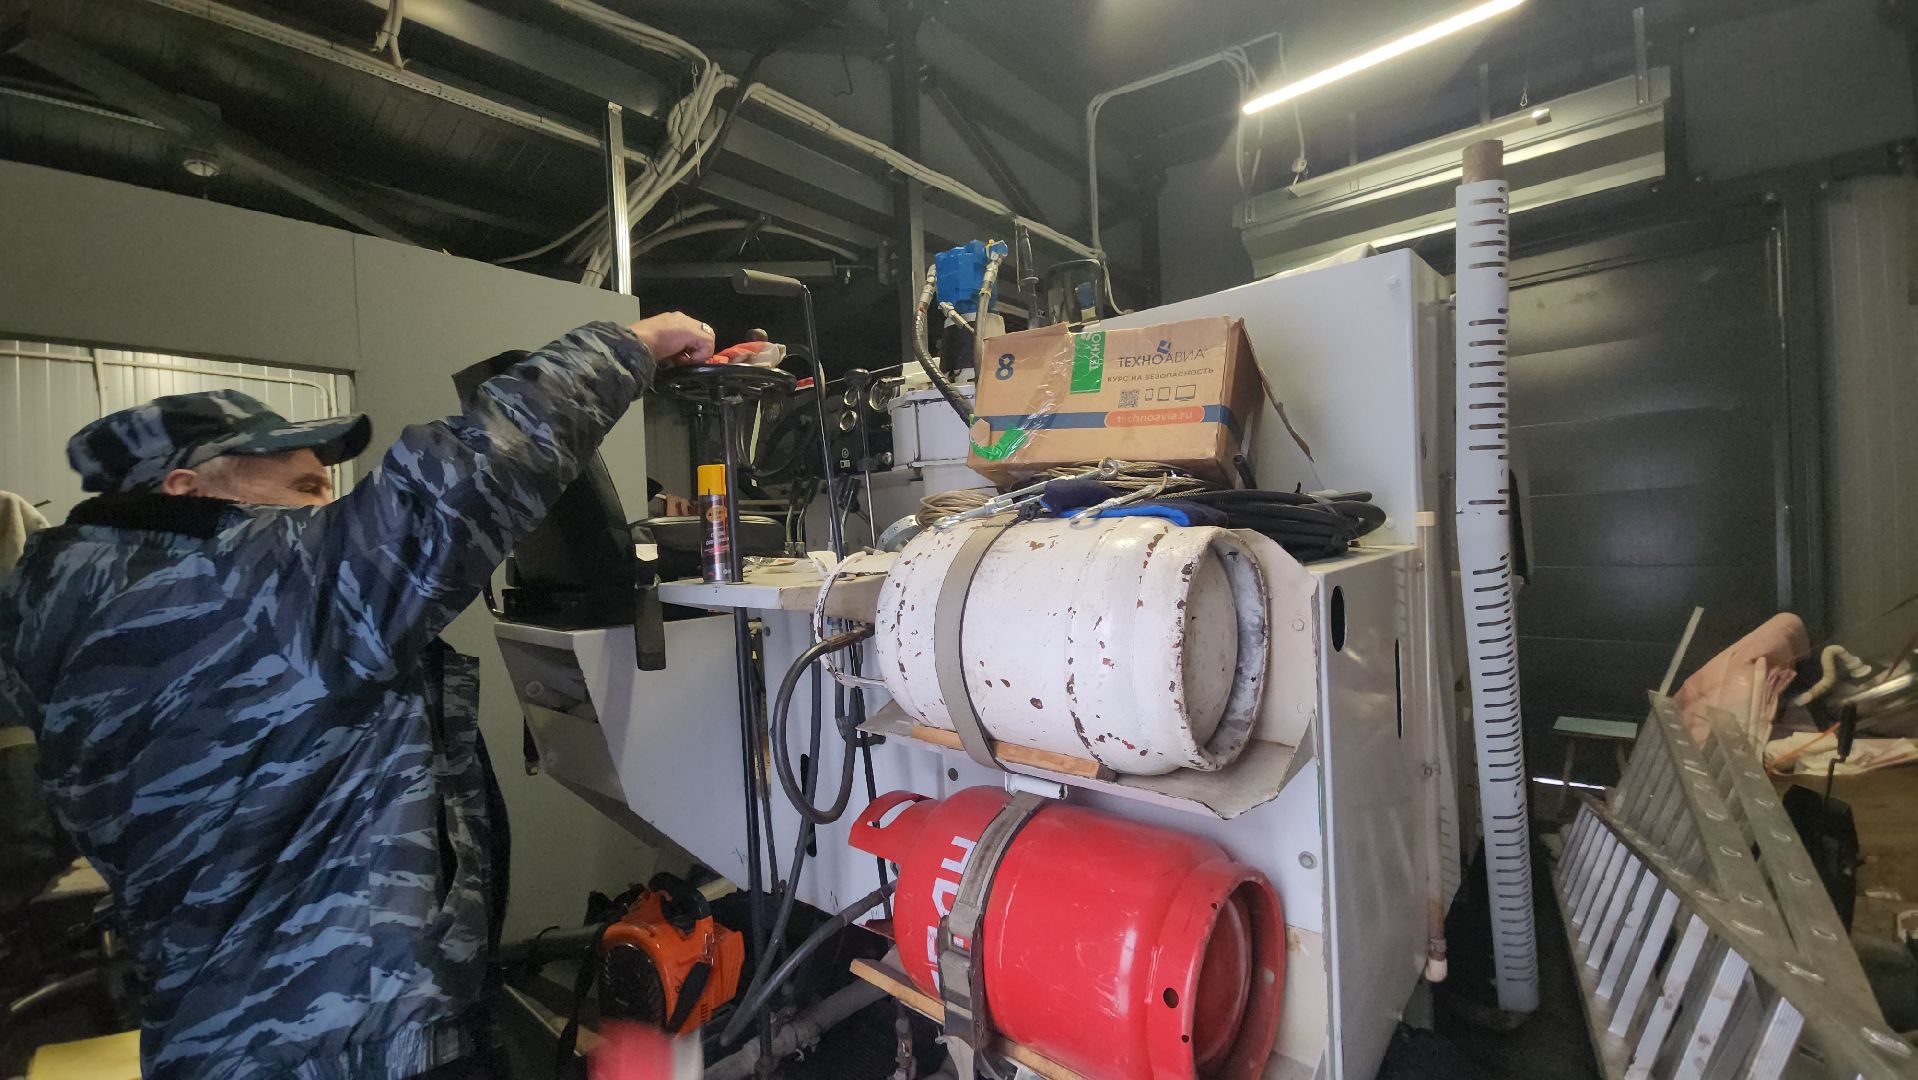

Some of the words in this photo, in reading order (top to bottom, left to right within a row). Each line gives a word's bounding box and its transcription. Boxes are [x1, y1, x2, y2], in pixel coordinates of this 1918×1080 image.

[1119, 348, 1205, 368] ТЕХНОАВИА
[995, 354, 1015, 381] 8
[1107, 375, 1129, 383] КУРС
[1145, 367, 1214, 381] БЕЗОПАСНОСТЬ
[1116, 411, 1193, 423] technoavia.ru
